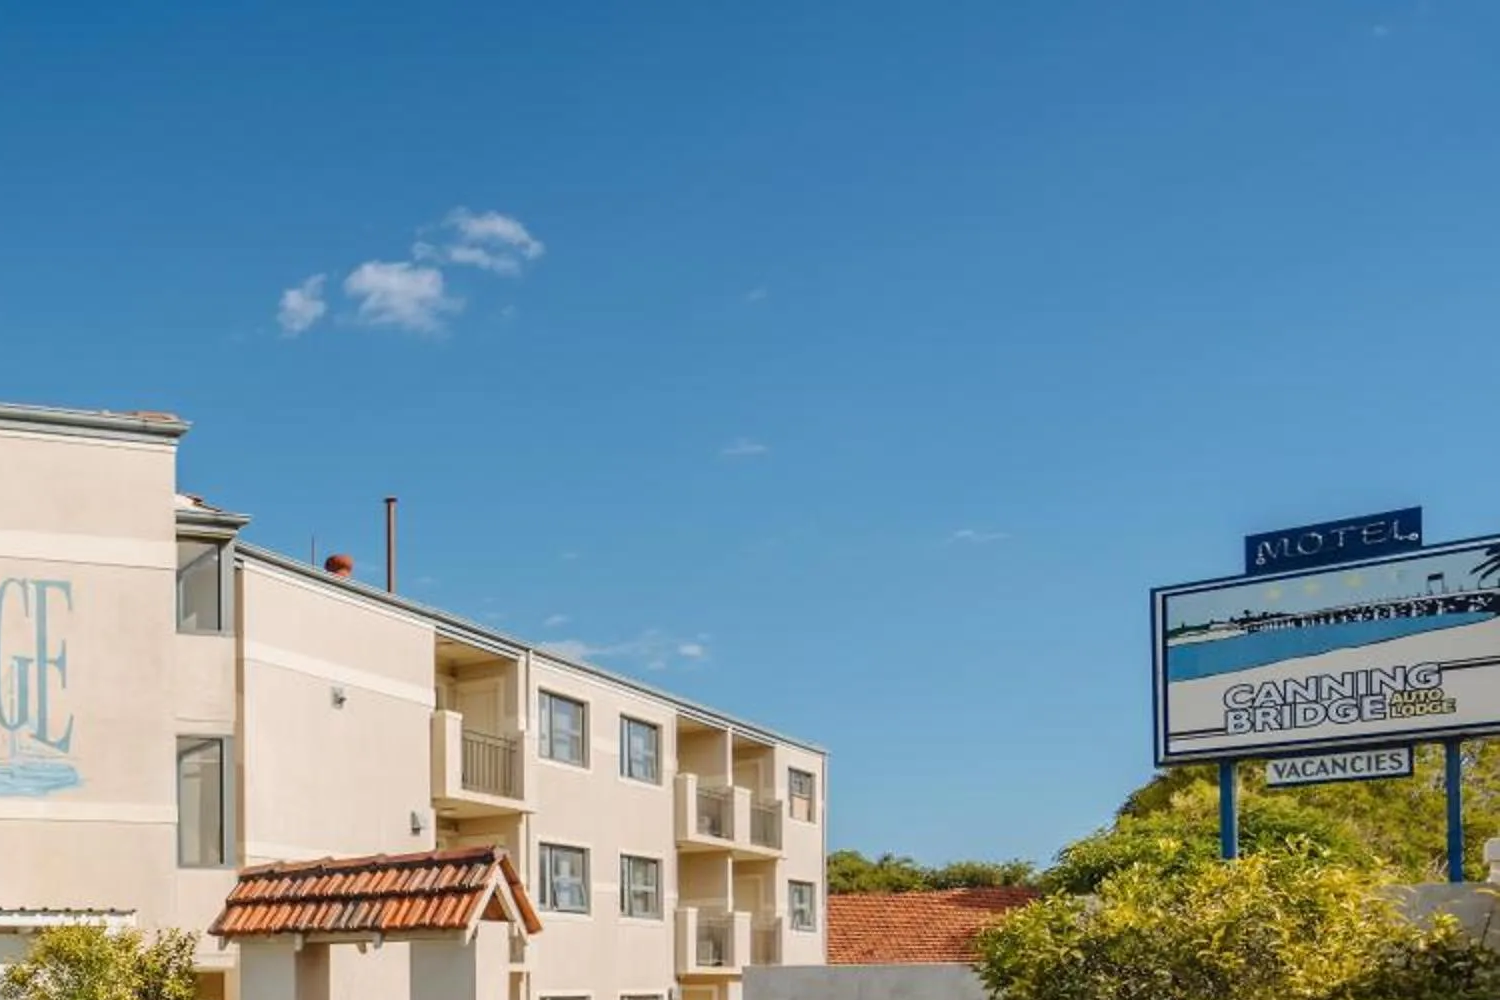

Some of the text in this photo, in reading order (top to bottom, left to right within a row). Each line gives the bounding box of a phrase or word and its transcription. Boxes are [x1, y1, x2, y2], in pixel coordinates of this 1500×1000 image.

[1257, 519, 1419, 565] MOTEL
[1224, 662, 1442, 710] CANNING
[1389, 687, 1445, 705] AUTO
[1225, 693, 1387, 735] BRIDGE
[1389, 698, 1457, 719] LODGE
[1272, 752, 1405, 780] VACANCIES
